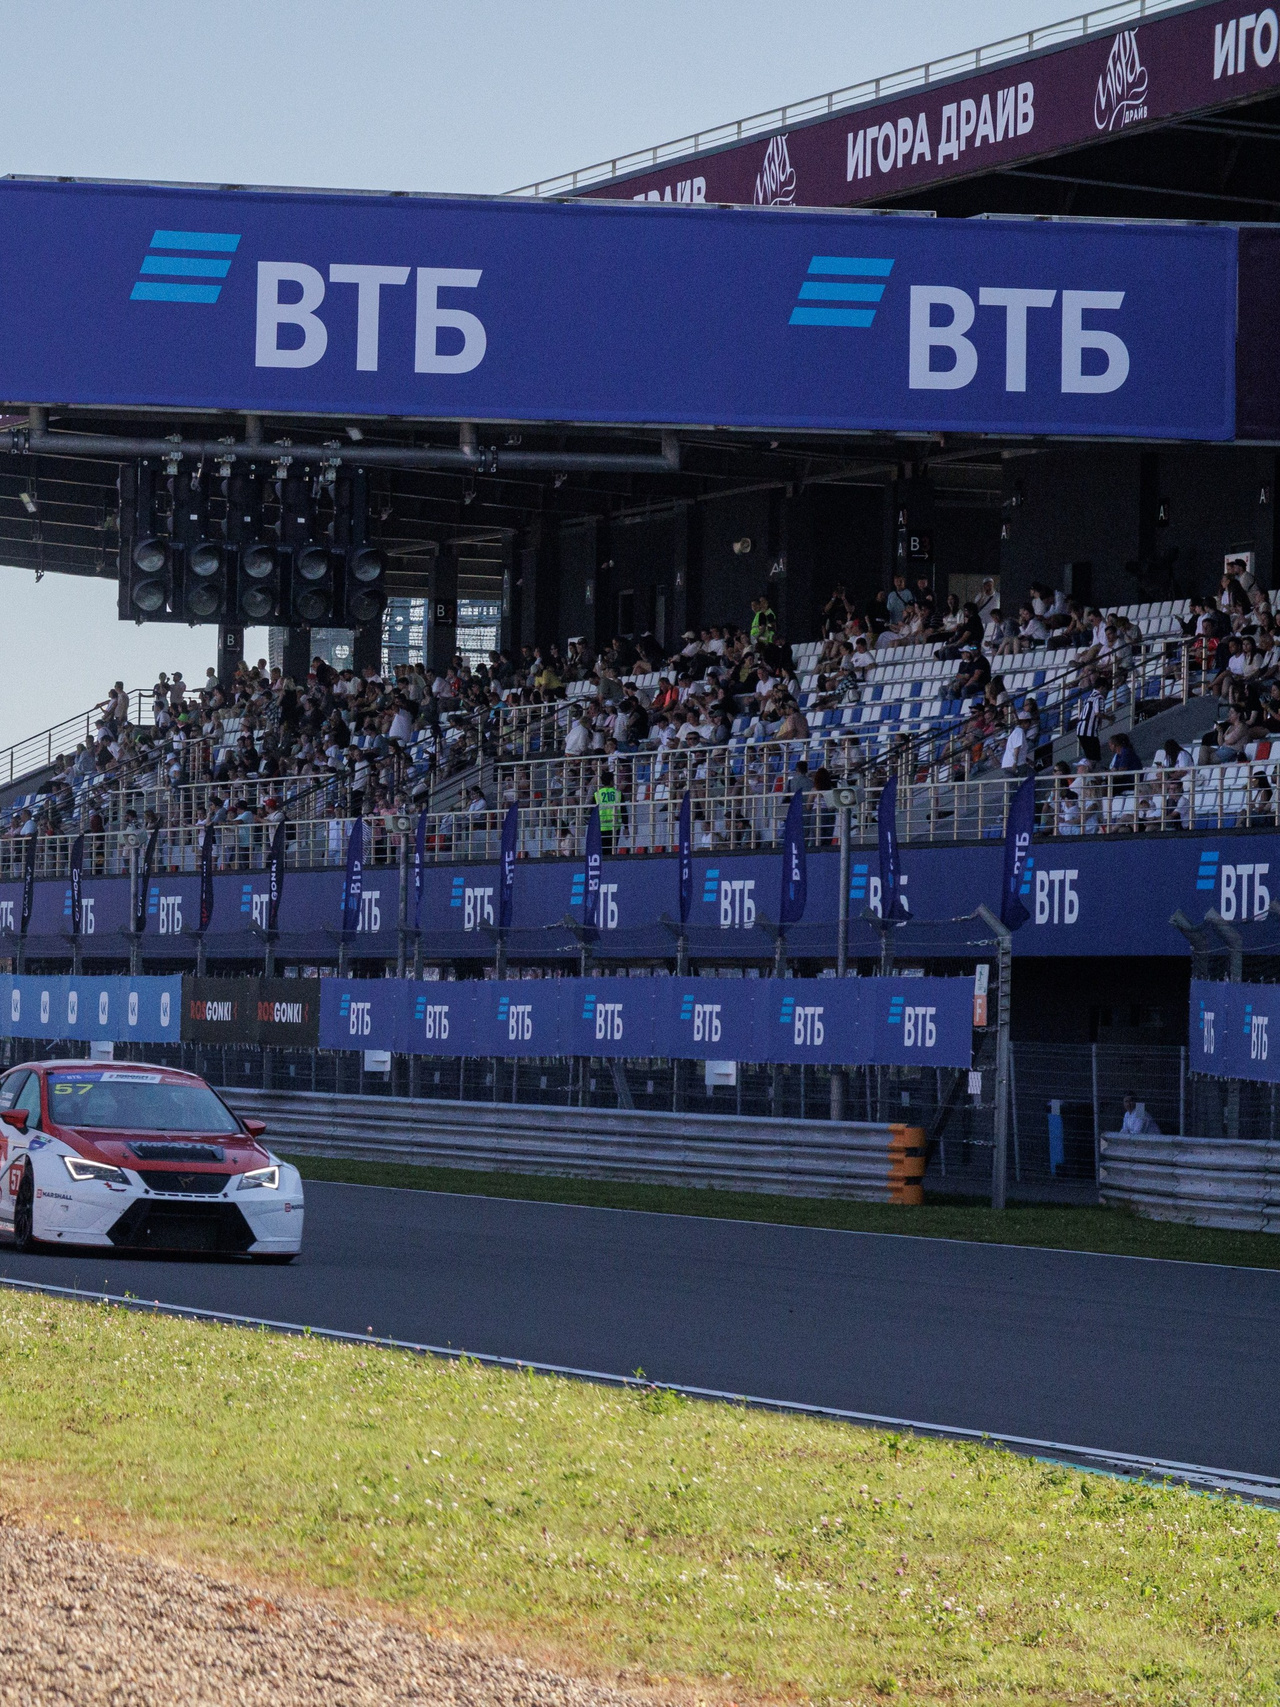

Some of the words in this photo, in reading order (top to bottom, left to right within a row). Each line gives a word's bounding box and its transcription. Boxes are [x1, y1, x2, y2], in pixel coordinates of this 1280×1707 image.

[1213, 8, 1280, 80] ИГО
[847, 111, 932, 182] ИГОРА
[938, 81, 1035, 165] ДРАЙВ
[255, 261, 487, 375] ВТБ
[908, 285, 1131, 394] ВТБ
[600, 791, 616, 802] 216
[464, 887, 494, 931] ВТБ
[721, 880, 756, 929] ВТБ
[1035, 869, 1080, 925] ВТБ
[1220, 863, 1270, 921] ВТБ
[159, 895, 182, 935] ВТБ
[190, 1000, 232, 1021] ROSGONKI
[257, 1001, 302, 1023] ROSGONKI
[349, 1002, 371, 1035] ВТБ
[426, 1005, 449, 1039] ВТБ
[509, 1005, 532, 1040] ВТБ
[596, 1003, 623, 1040] ВТБ
[694, 1004, 721, 1042] ВТБ
[794, 1006, 824, 1046] ВТБ
[903, 1006, 937, 1048] ВТБ
[1203, 1011, 1215, 1054] ВТБ
[1250, 1016, 1269, 1061] ВТБ
[54, 1083, 94, 1095] 57
[42, 1191, 73, 1201] MARSHALL
